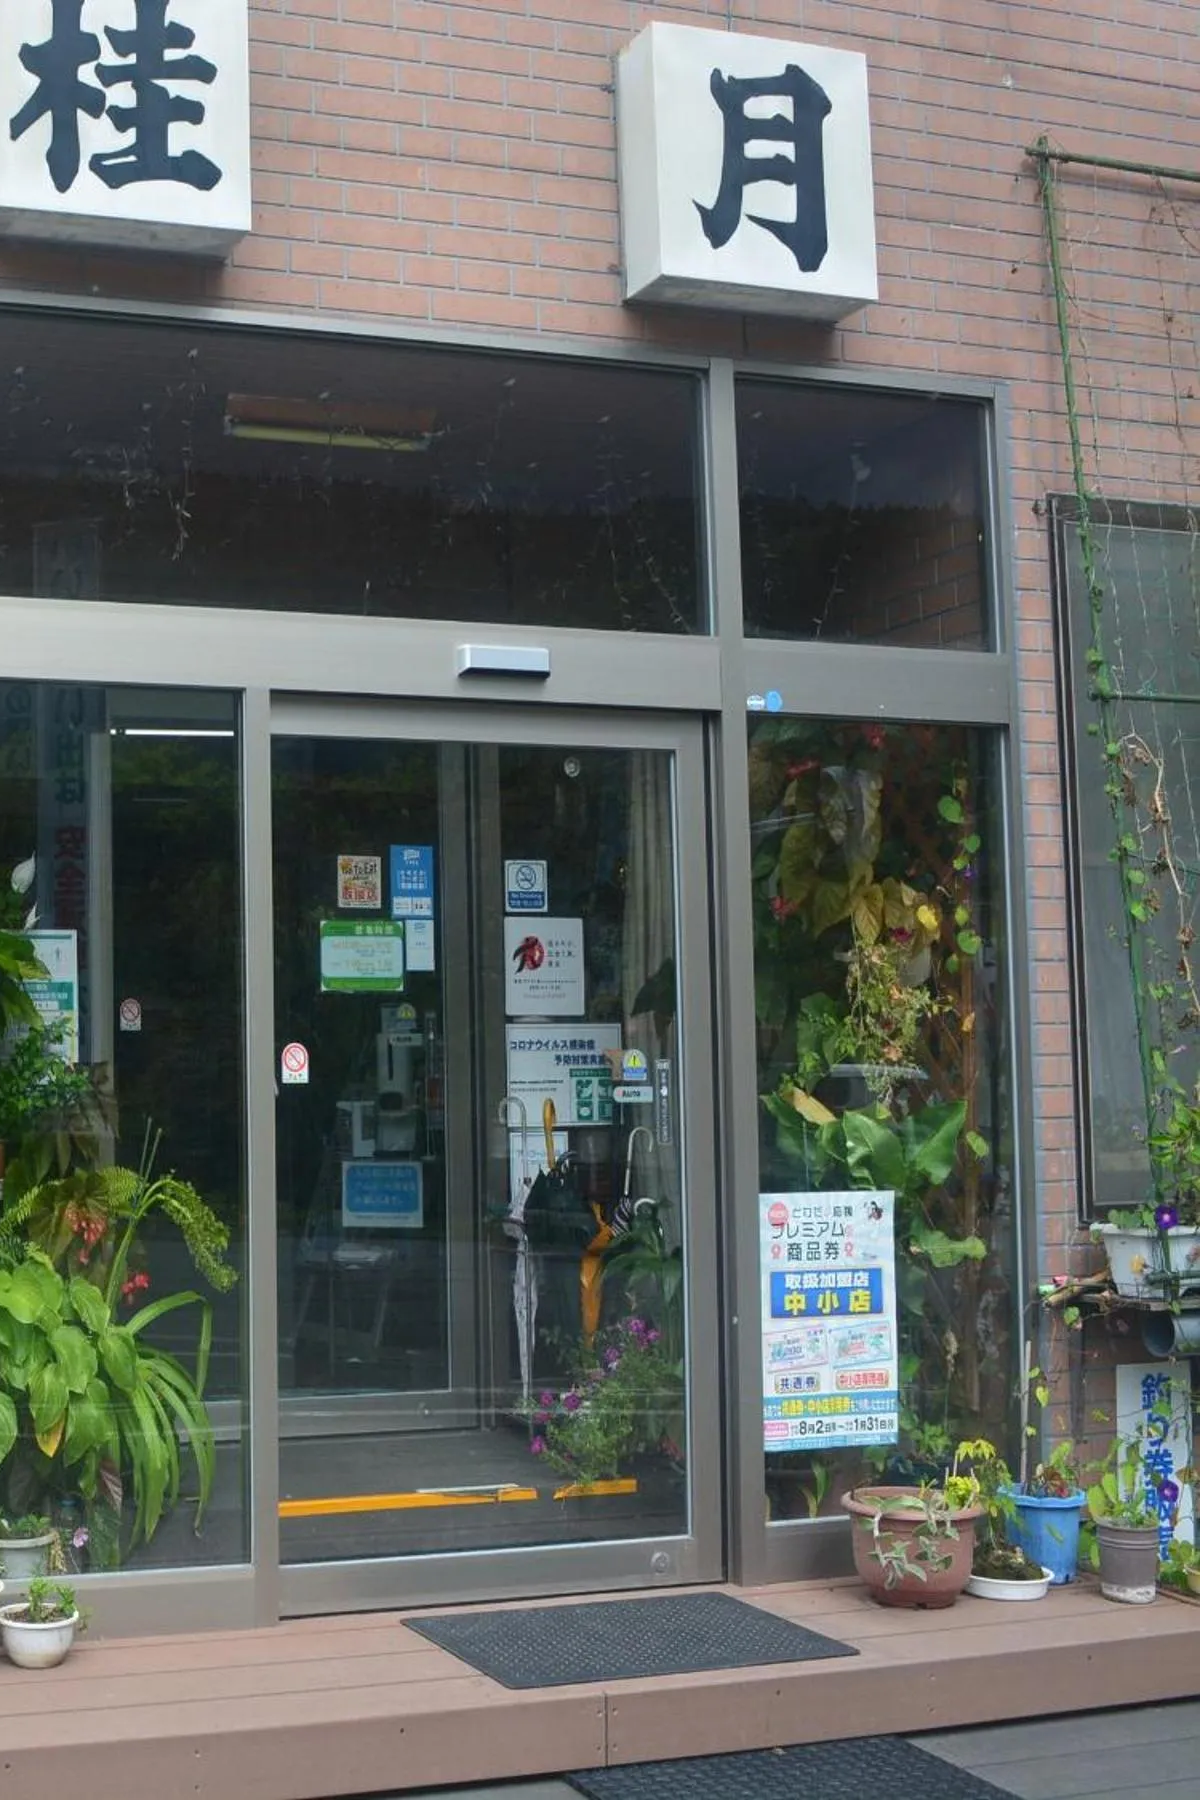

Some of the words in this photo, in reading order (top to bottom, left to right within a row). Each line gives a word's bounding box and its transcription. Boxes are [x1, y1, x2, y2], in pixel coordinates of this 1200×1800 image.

[9, 0, 223, 192] 桂
[693, 64, 833, 273] 月
[510, 1039, 596, 1051] コロナウイルス感染症
[787, 1241, 840, 1261] 商品券
[784, 1272, 870, 1289] 取扱加盟店
[784, 1289, 872, 1315] 中小店
